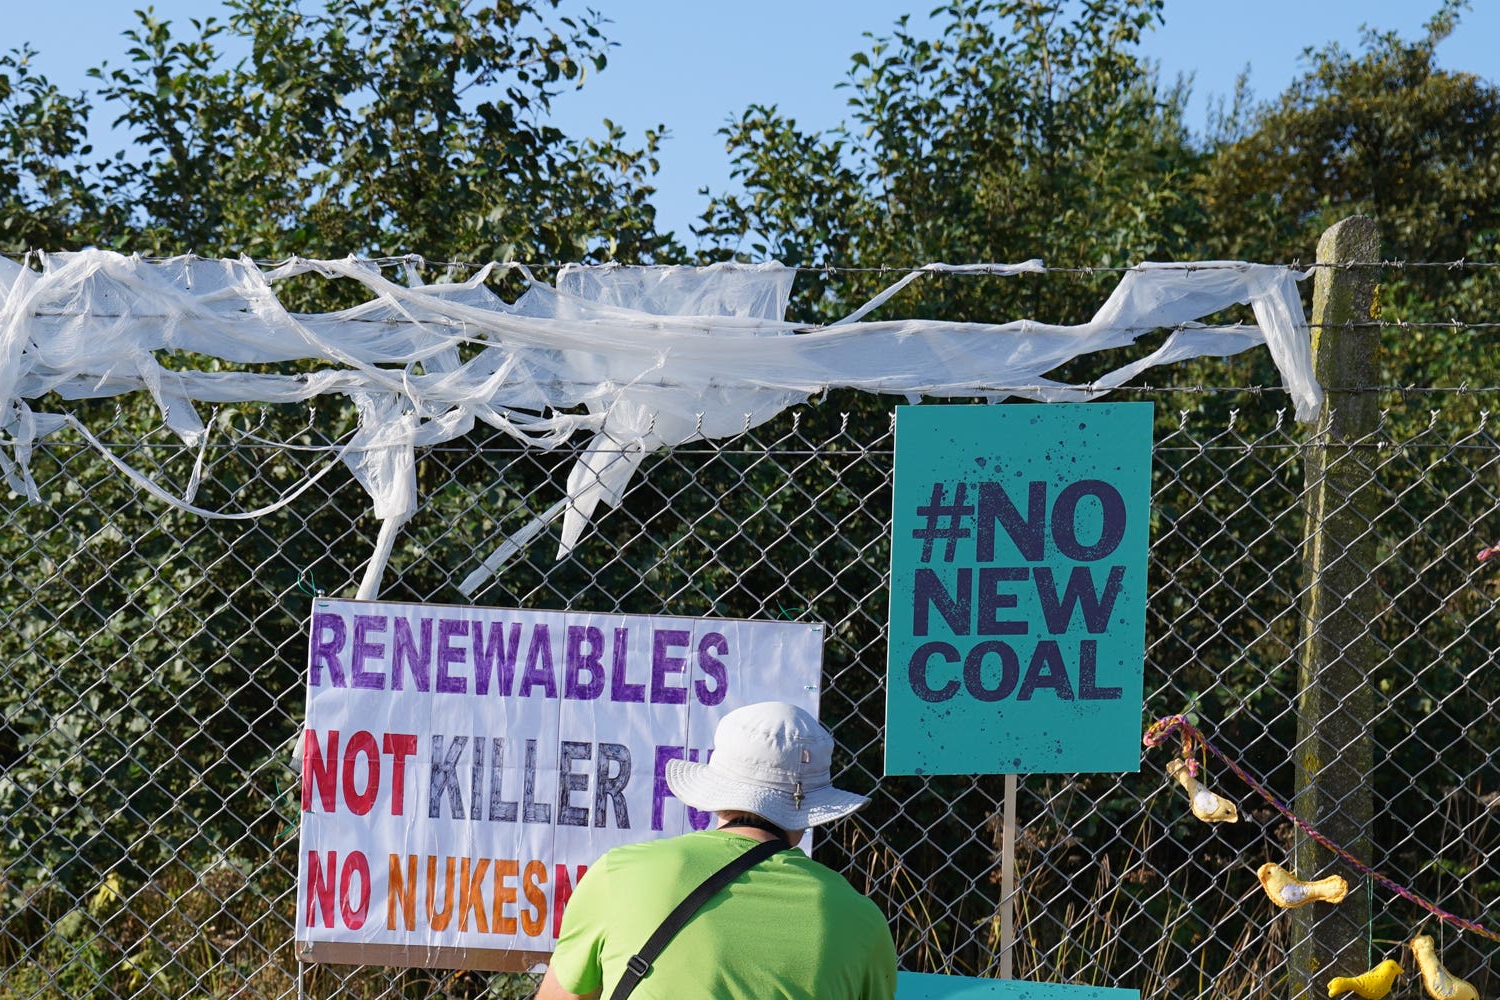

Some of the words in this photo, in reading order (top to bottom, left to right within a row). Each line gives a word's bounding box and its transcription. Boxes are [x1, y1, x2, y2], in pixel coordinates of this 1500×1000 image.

[911, 479, 1127, 563] #NO
[912, 566, 1126, 637] NEW
[308, 612, 730, 706] RENEWABLES
[908, 639, 1123, 703] COAL
[301, 729, 418, 816] NOT
[428, 734, 632, 830] KILLER
[306, 849, 371, 930] NO
[387, 853, 547, 937] NUKES
